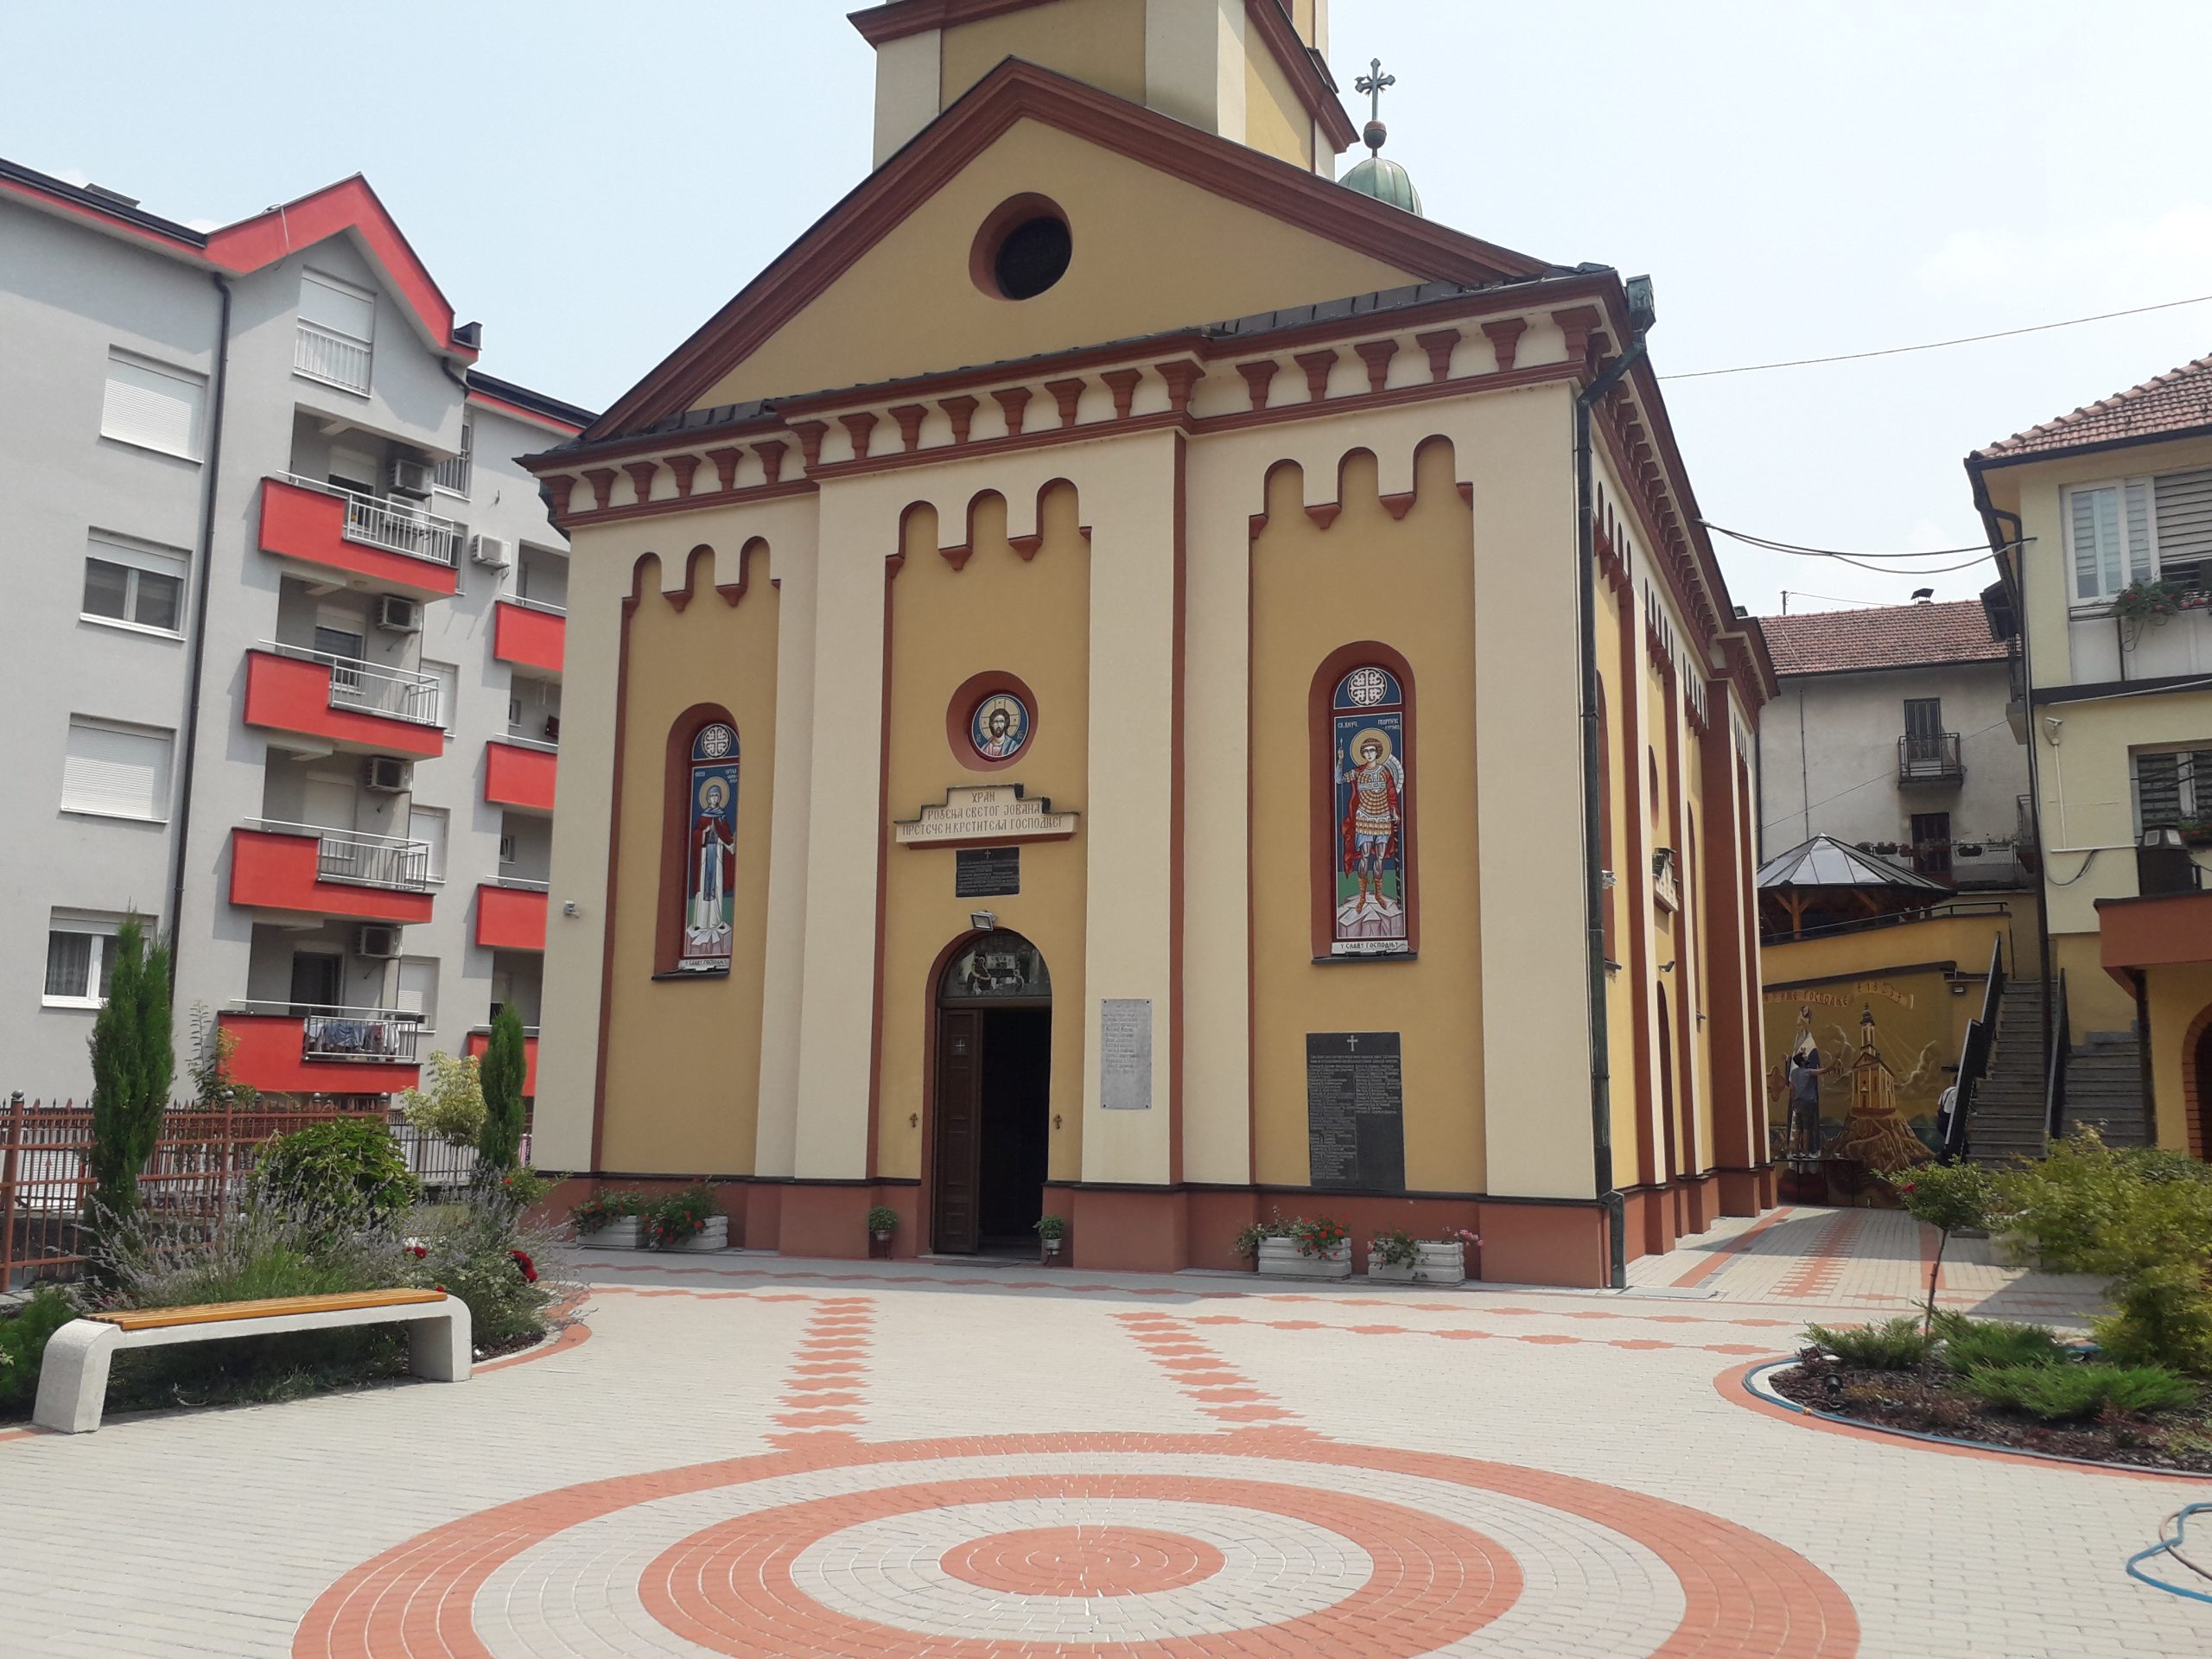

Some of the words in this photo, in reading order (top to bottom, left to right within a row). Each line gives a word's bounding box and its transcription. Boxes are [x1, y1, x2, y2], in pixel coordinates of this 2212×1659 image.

[965, 804, 1000, 818] СВЕТОГ
[1003, 803, 1040, 816] ЈОВАНА
[945, 823, 951, 834] И
